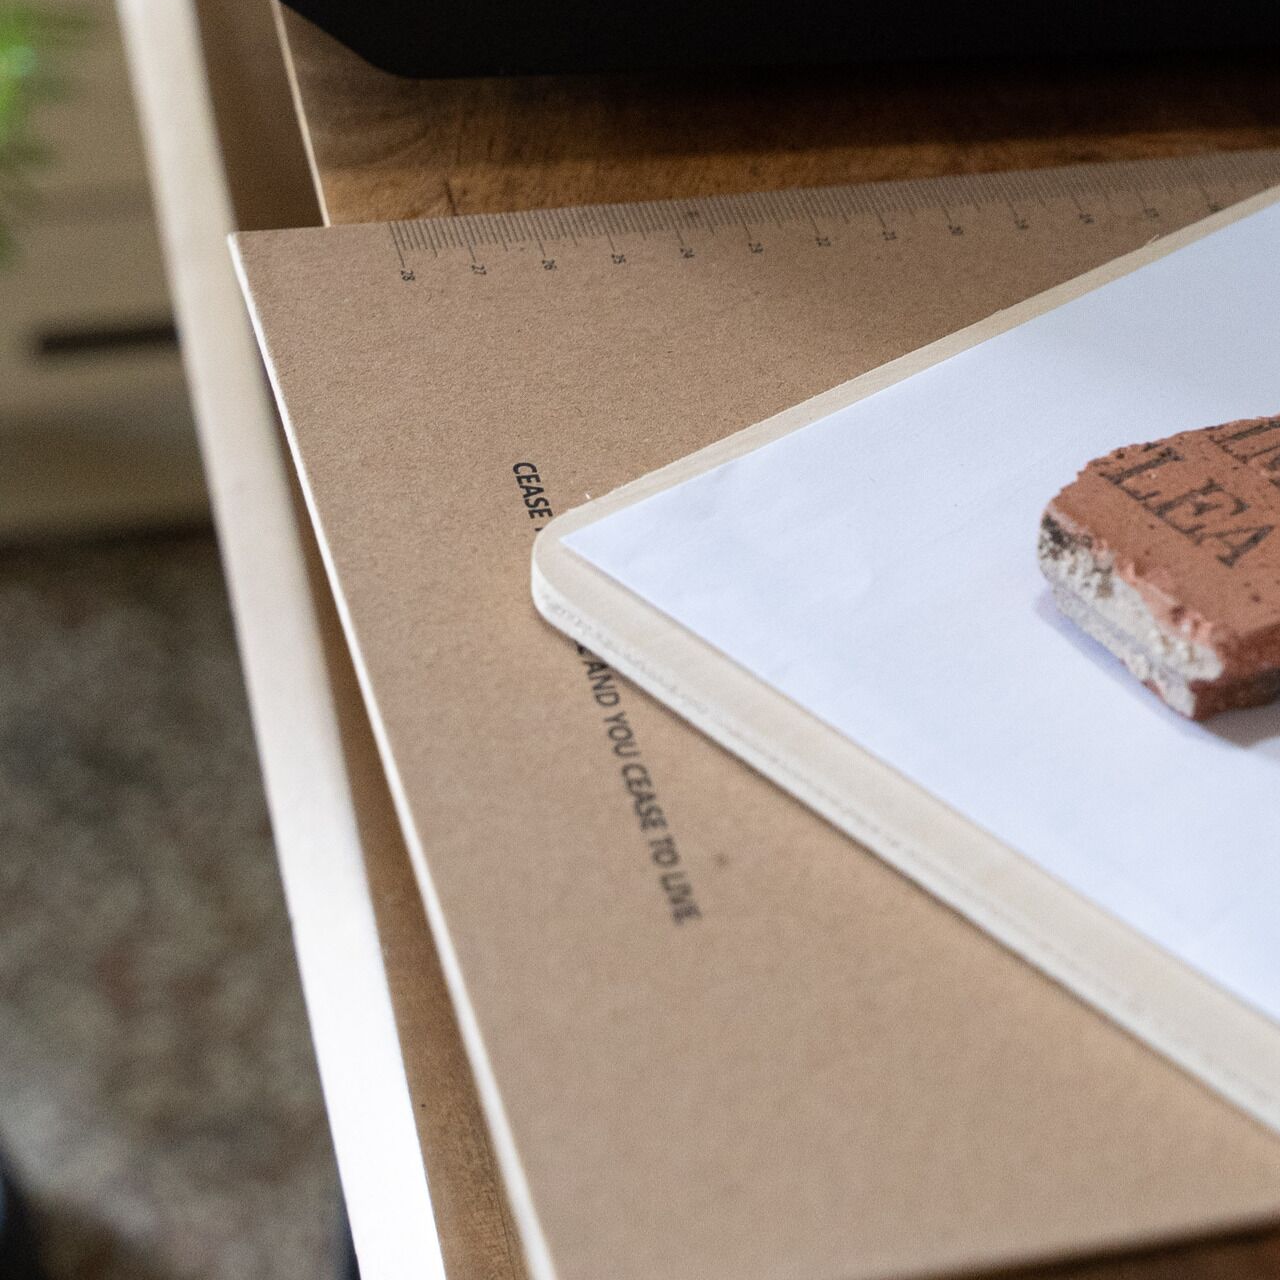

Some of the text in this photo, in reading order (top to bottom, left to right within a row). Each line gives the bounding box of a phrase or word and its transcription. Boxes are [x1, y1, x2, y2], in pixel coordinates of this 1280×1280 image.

[400, 269, 416, 282] 28
[470, 263, 488, 276] 27
[541, 258, 558, 271] 26
[512, 462, 553, 520] CEASE
[583, 659, 620, 708] AND
[603, 710, 641, 759] YOU
[621, 762, 669, 833] CEASE
[649, 833, 680, 868] TO
